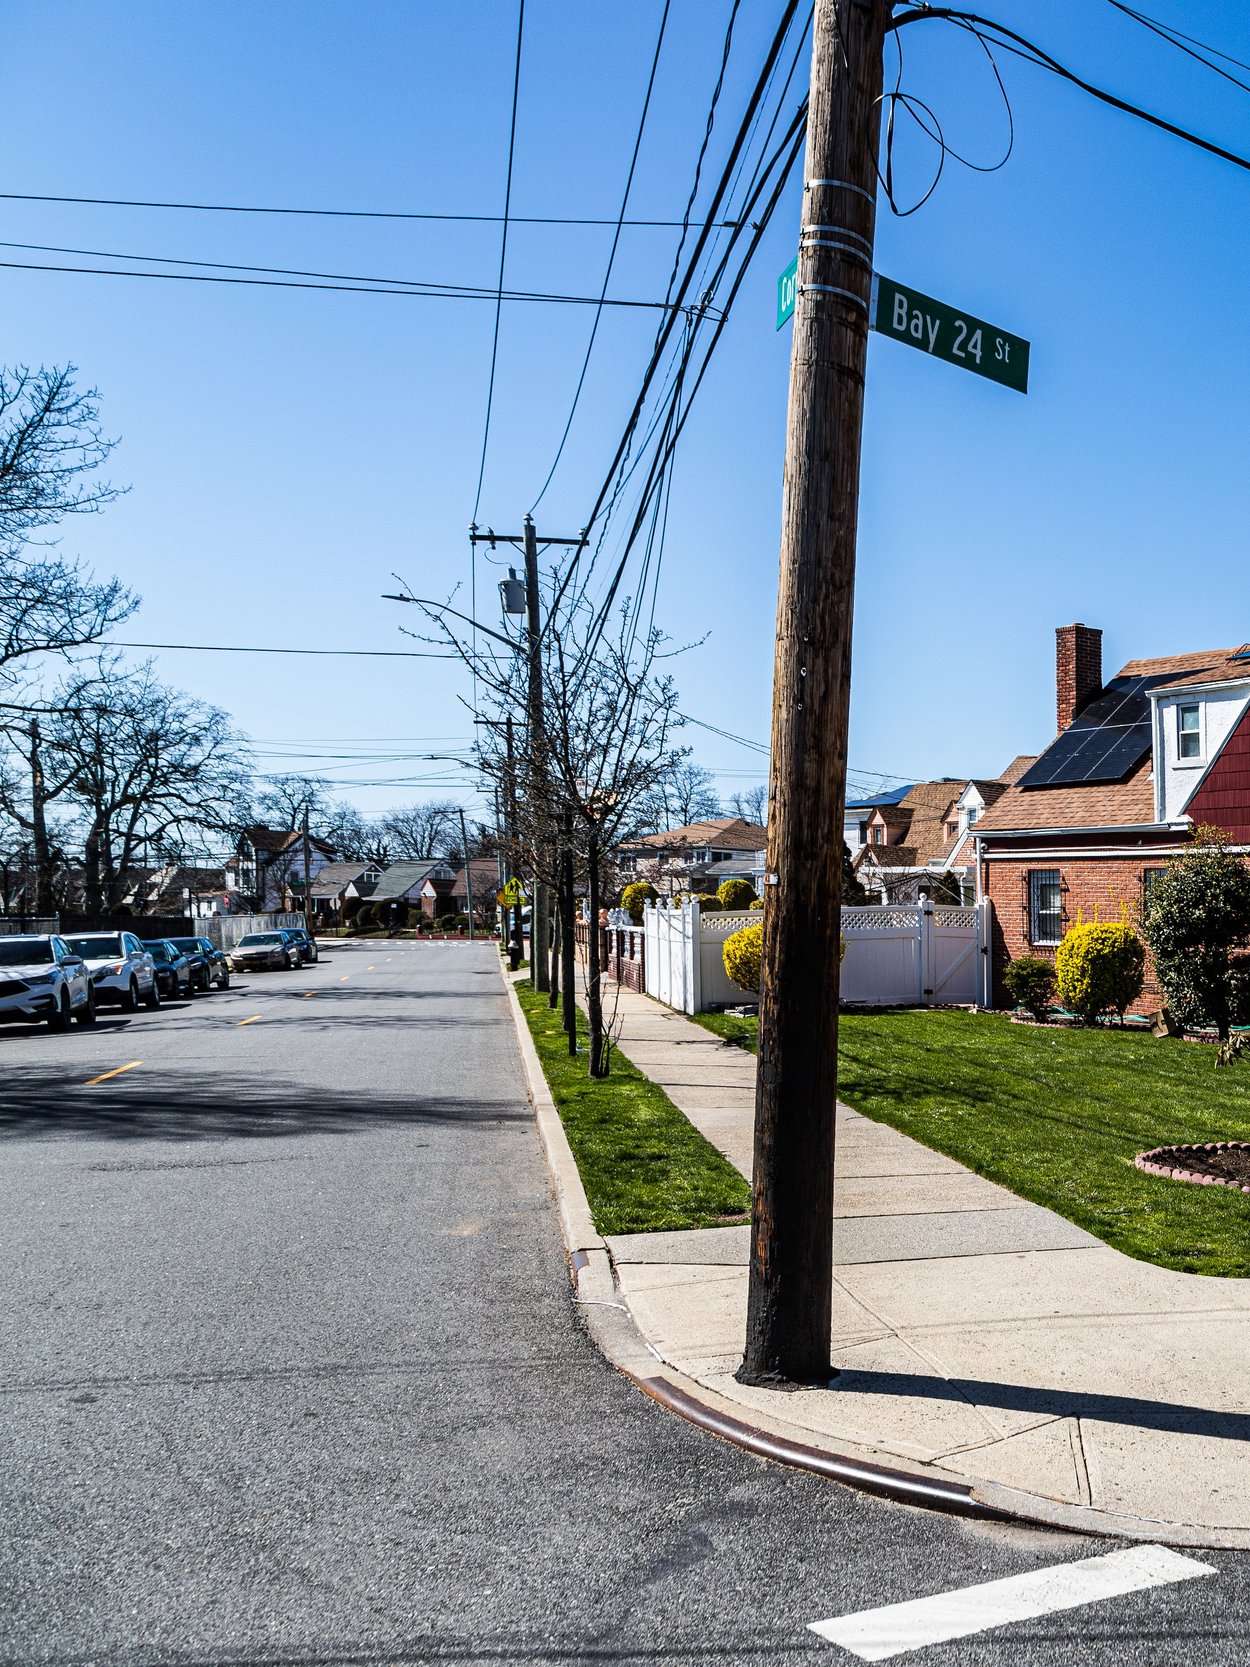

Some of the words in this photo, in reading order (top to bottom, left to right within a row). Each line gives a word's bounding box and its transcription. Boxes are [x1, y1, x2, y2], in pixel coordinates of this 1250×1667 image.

[782, 271, 798, 312] Cor
[893, 292, 941, 353] Bay
[952, 320, 983, 364] 24
[995, 338, 1011, 363] St
